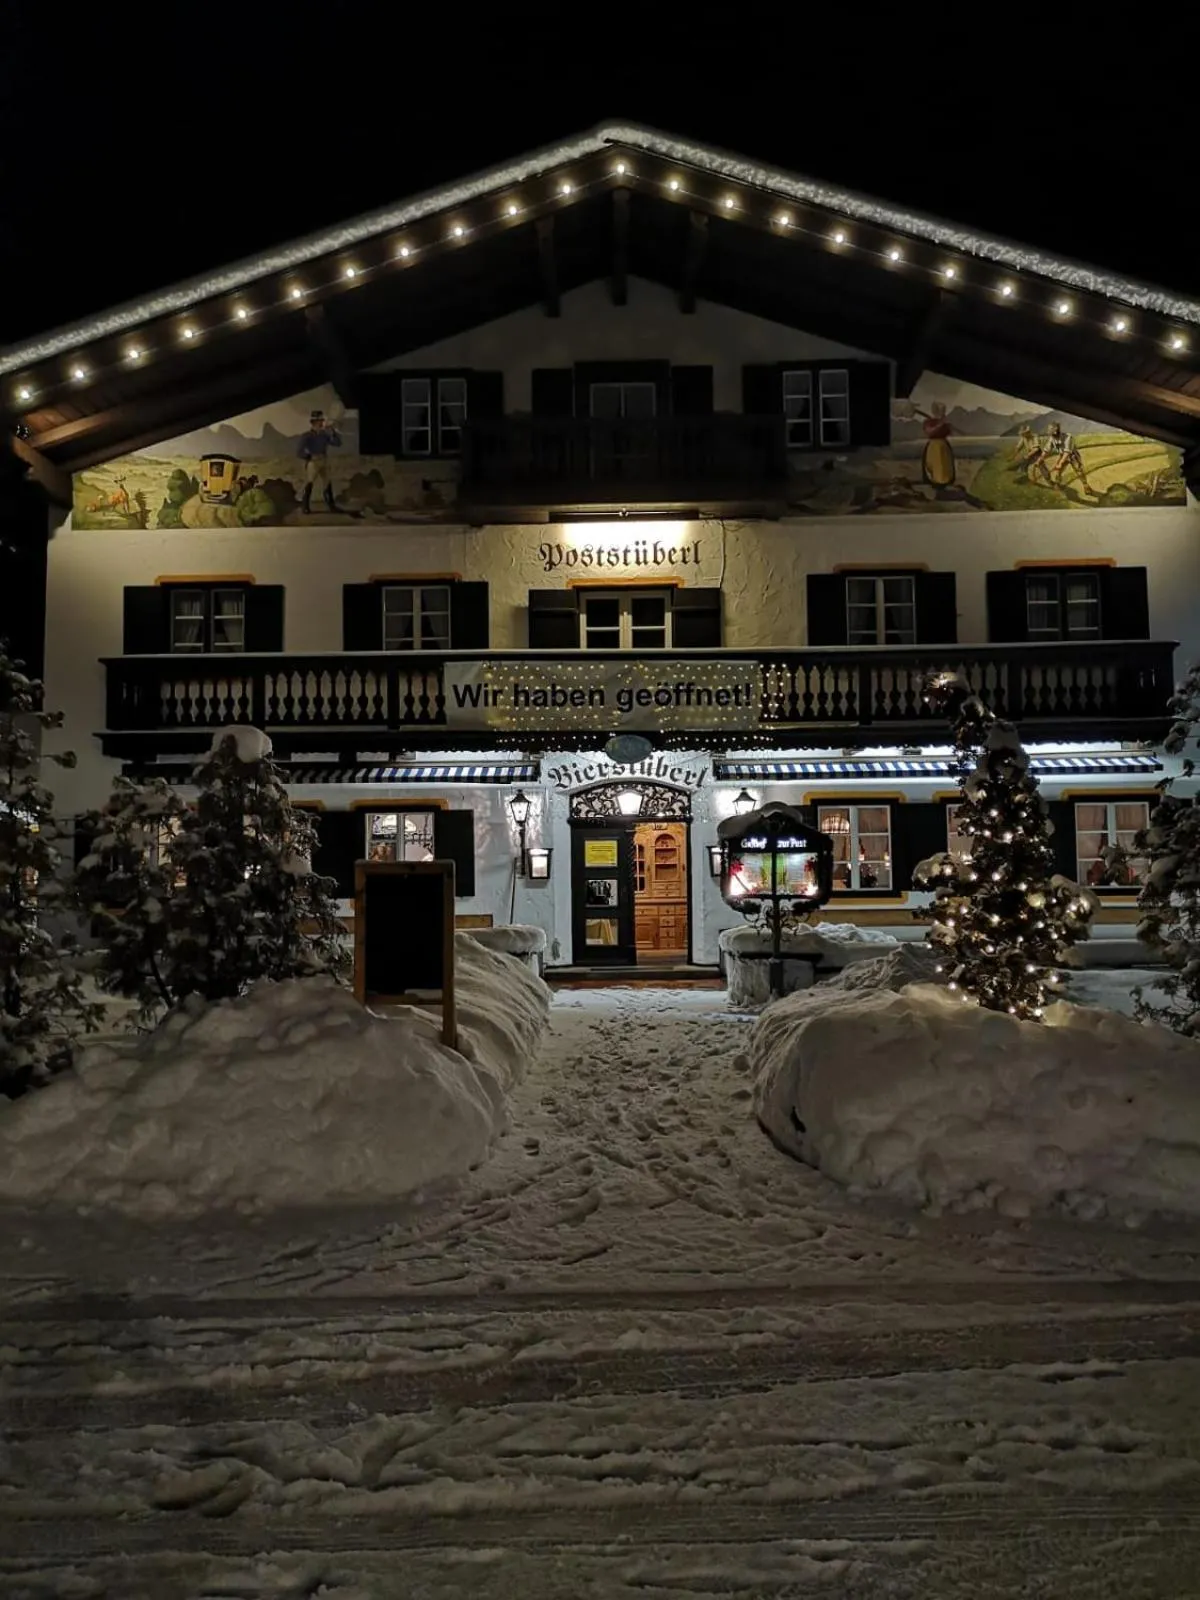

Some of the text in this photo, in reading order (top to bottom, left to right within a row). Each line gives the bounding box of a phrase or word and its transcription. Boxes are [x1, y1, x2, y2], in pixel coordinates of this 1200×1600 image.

[538, 540, 702, 572] Poststüberl
[452, 681, 752, 713] Wir haben geöffnet!
[789, 837, 808, 848] Post
